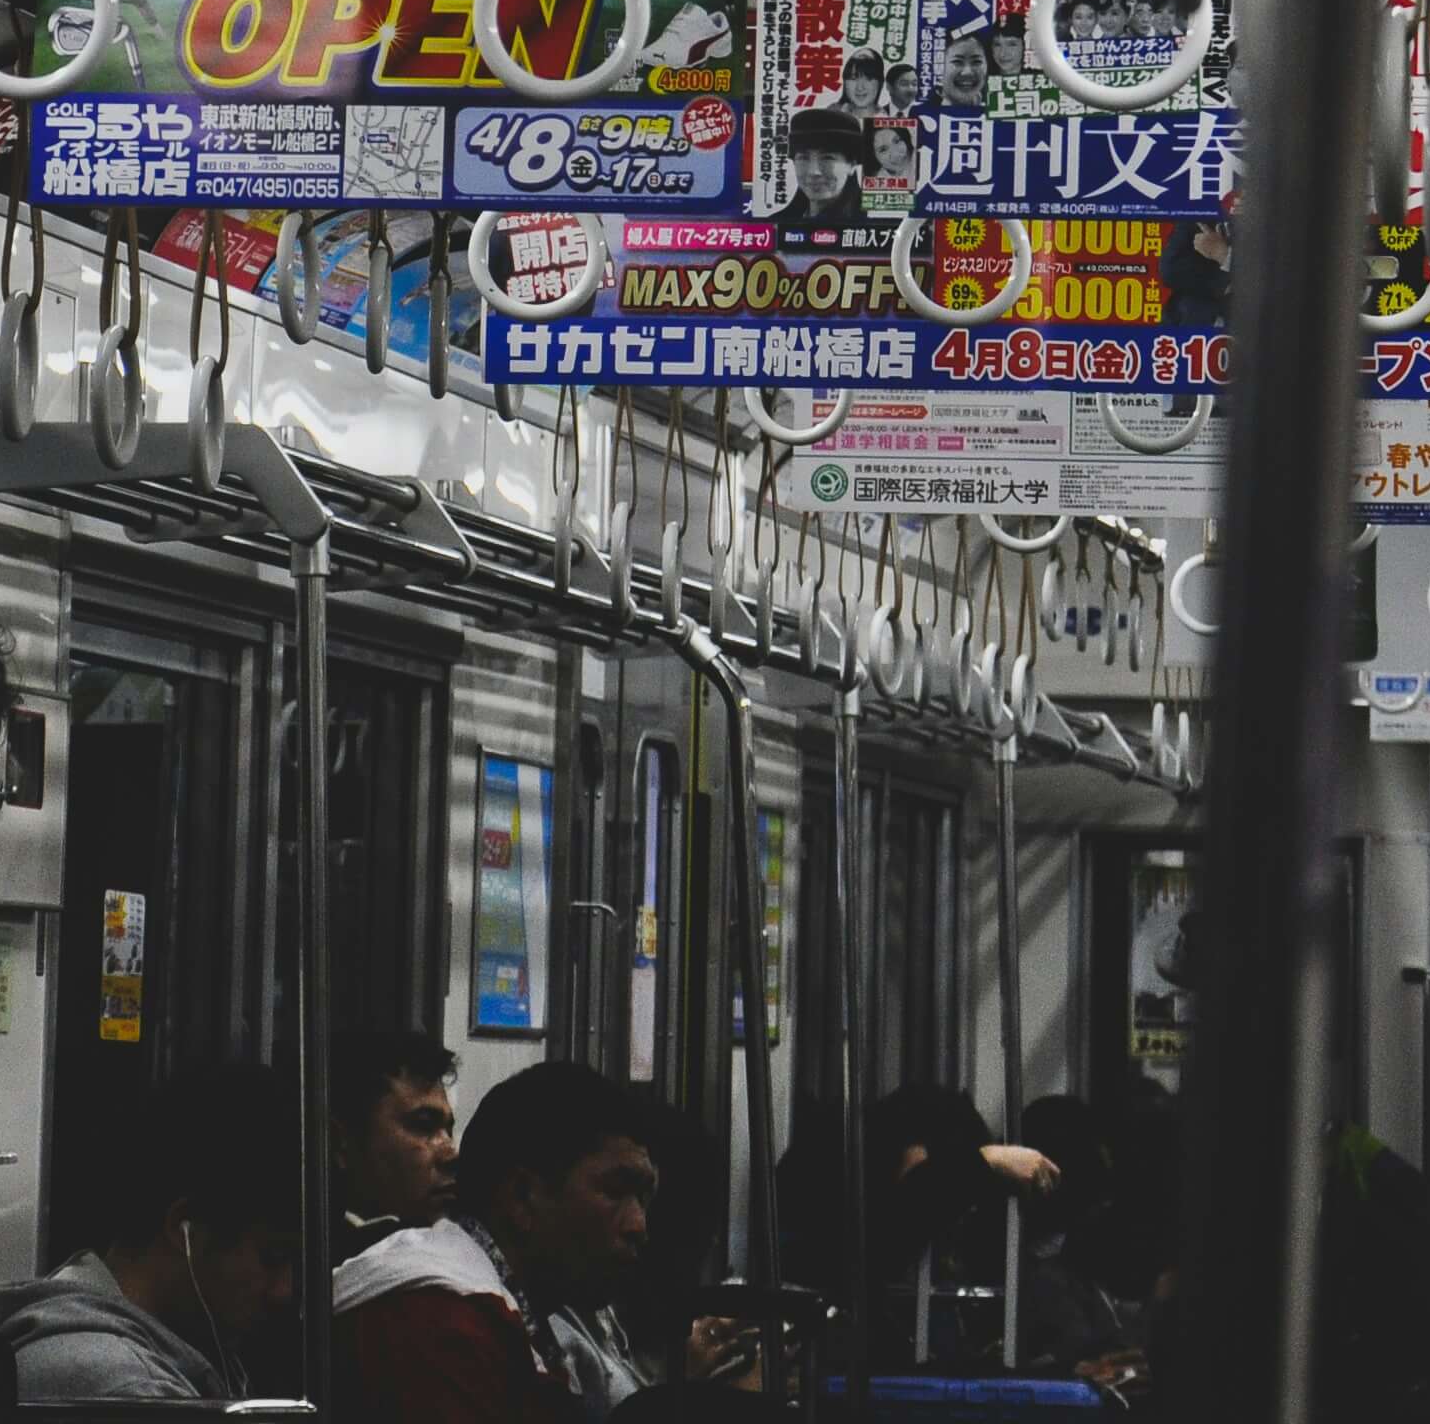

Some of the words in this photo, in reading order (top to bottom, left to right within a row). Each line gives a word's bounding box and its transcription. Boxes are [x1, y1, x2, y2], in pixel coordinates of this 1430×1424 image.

[657, 69, 732, 92] 4,800円
[46, 102, 94, 117] GOLF
[199, 104, 342, 131] 東武新船橋駅前、
[687, 102, 724, 119] オープン
[45, 103, 194, 141] つるや
[43, 140, 191, 159] イオンモール
[199, 132, 342, 153] イオンモール船橋2F
[917, 110, 1251, 202] 週刊文春
[42, 158, 192, 198] 船橋店
[212, 176, 340, 199] 047(495)0555
[511, 228, 589, 273] 開店
[953, 235, 979, 246] OFF
[1386, 235, 1413, 246] OFF
[506, 325, 918, 381] サカゼン南船橋店
[932, 327, 1142, 384] 4月8日(金)
[839, 433, 933, 451] 進学相談会
[853, 477, 1050, 505] 国際医療福祉大学
